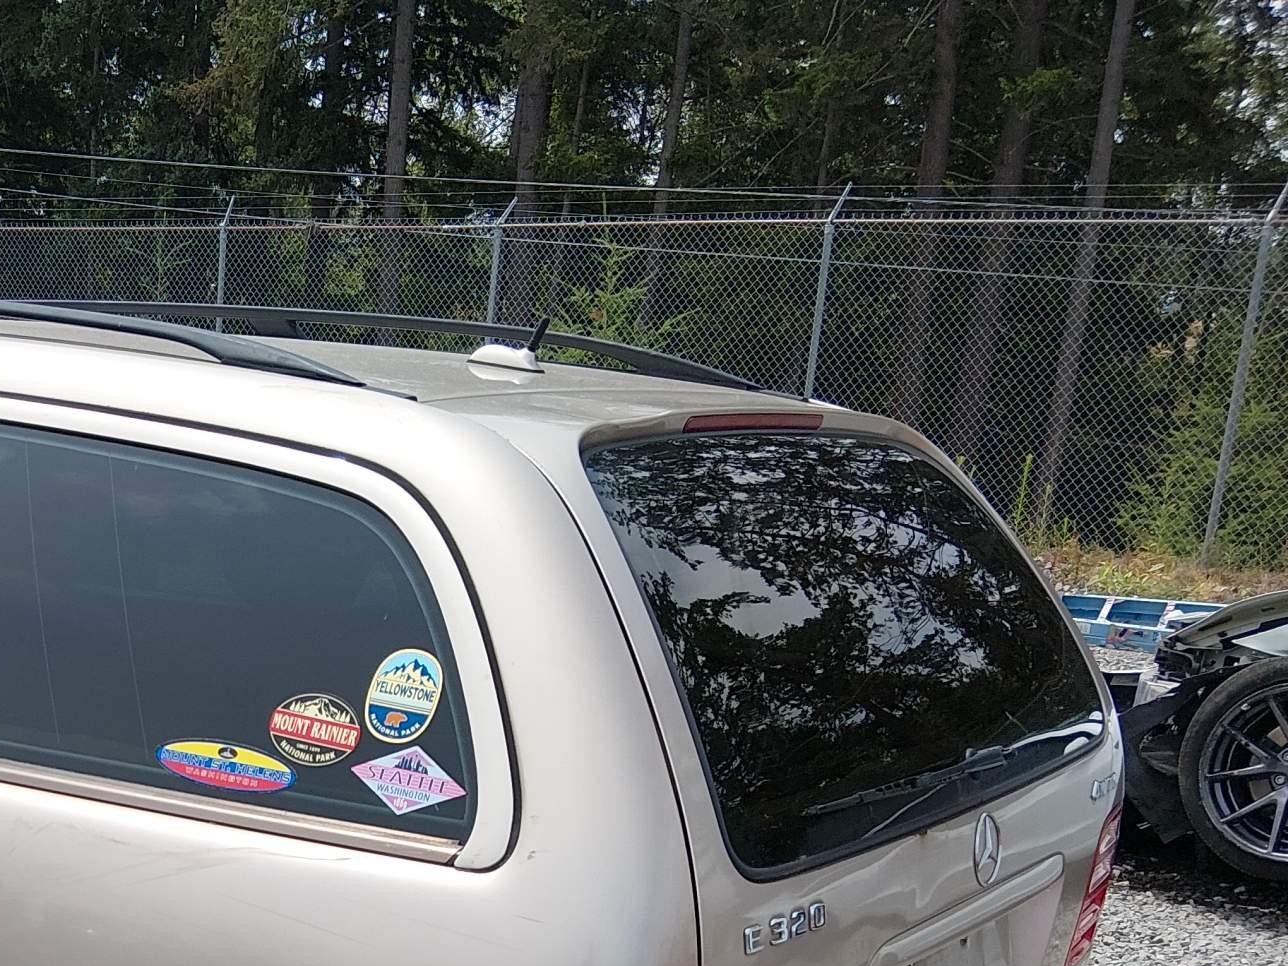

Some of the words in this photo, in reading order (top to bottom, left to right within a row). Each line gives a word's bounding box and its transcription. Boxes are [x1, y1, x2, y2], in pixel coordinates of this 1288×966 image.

[375, 680, 436, 703] YELLOWSTONE
[272, 712, 311, 736] MOUNT
[310, 721, 358, 746] RAINIER
[370, 713, 399, 737] NATIONAL
[401, 722, 421, 737] PARK
[280, 740, 313, 762] NATIONAL
[315, 751, 336, 763] PARK
[161, 748, 208, 769] MOUNT
[210, 759, 231, 771] ST.
[235, 763, 292, 784] HELENS
[185, 766, 259, 788] WASHINGTON
[377, 783, 431, 802] WASHINGTON
[743, 924, 765, 956] E
[769, 901, 826, 946] 320
